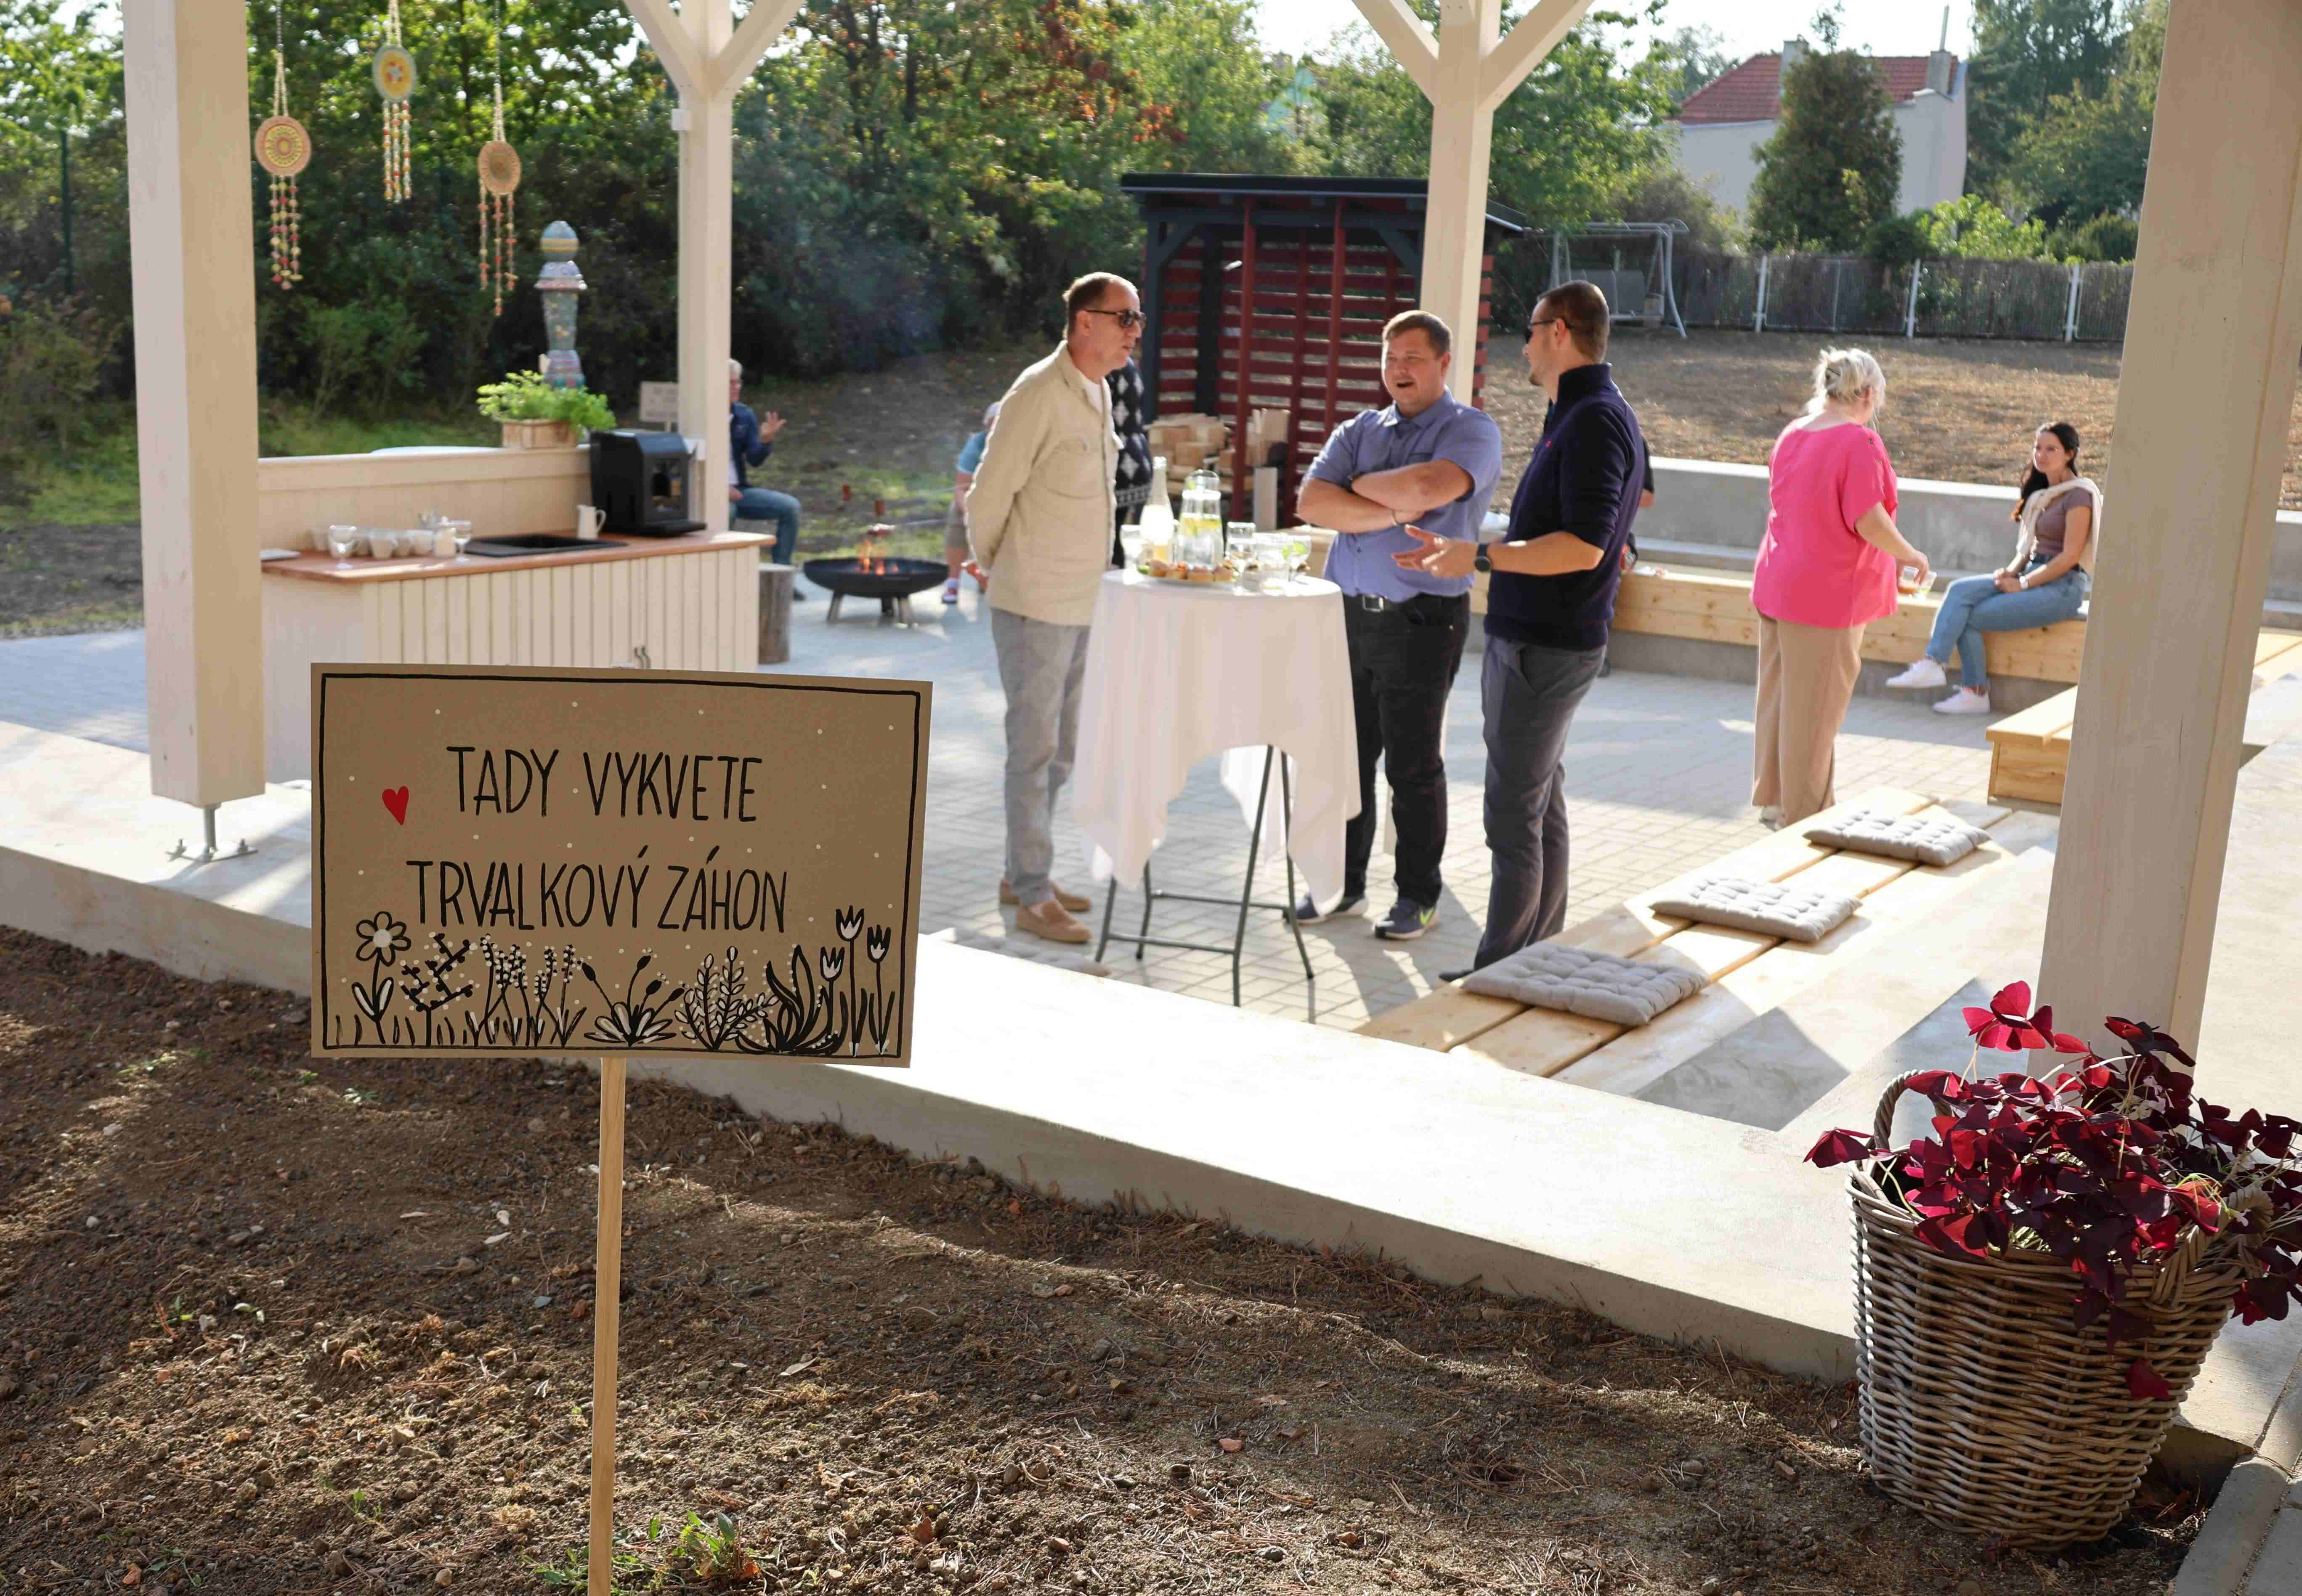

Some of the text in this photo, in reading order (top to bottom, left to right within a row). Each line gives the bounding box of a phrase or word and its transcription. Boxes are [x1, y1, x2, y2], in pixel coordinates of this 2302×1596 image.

[446, 746, 763, 822] TADY VYKVETE
[405, 845, 788, 933] TRVALKOVÝ ZÁHON
